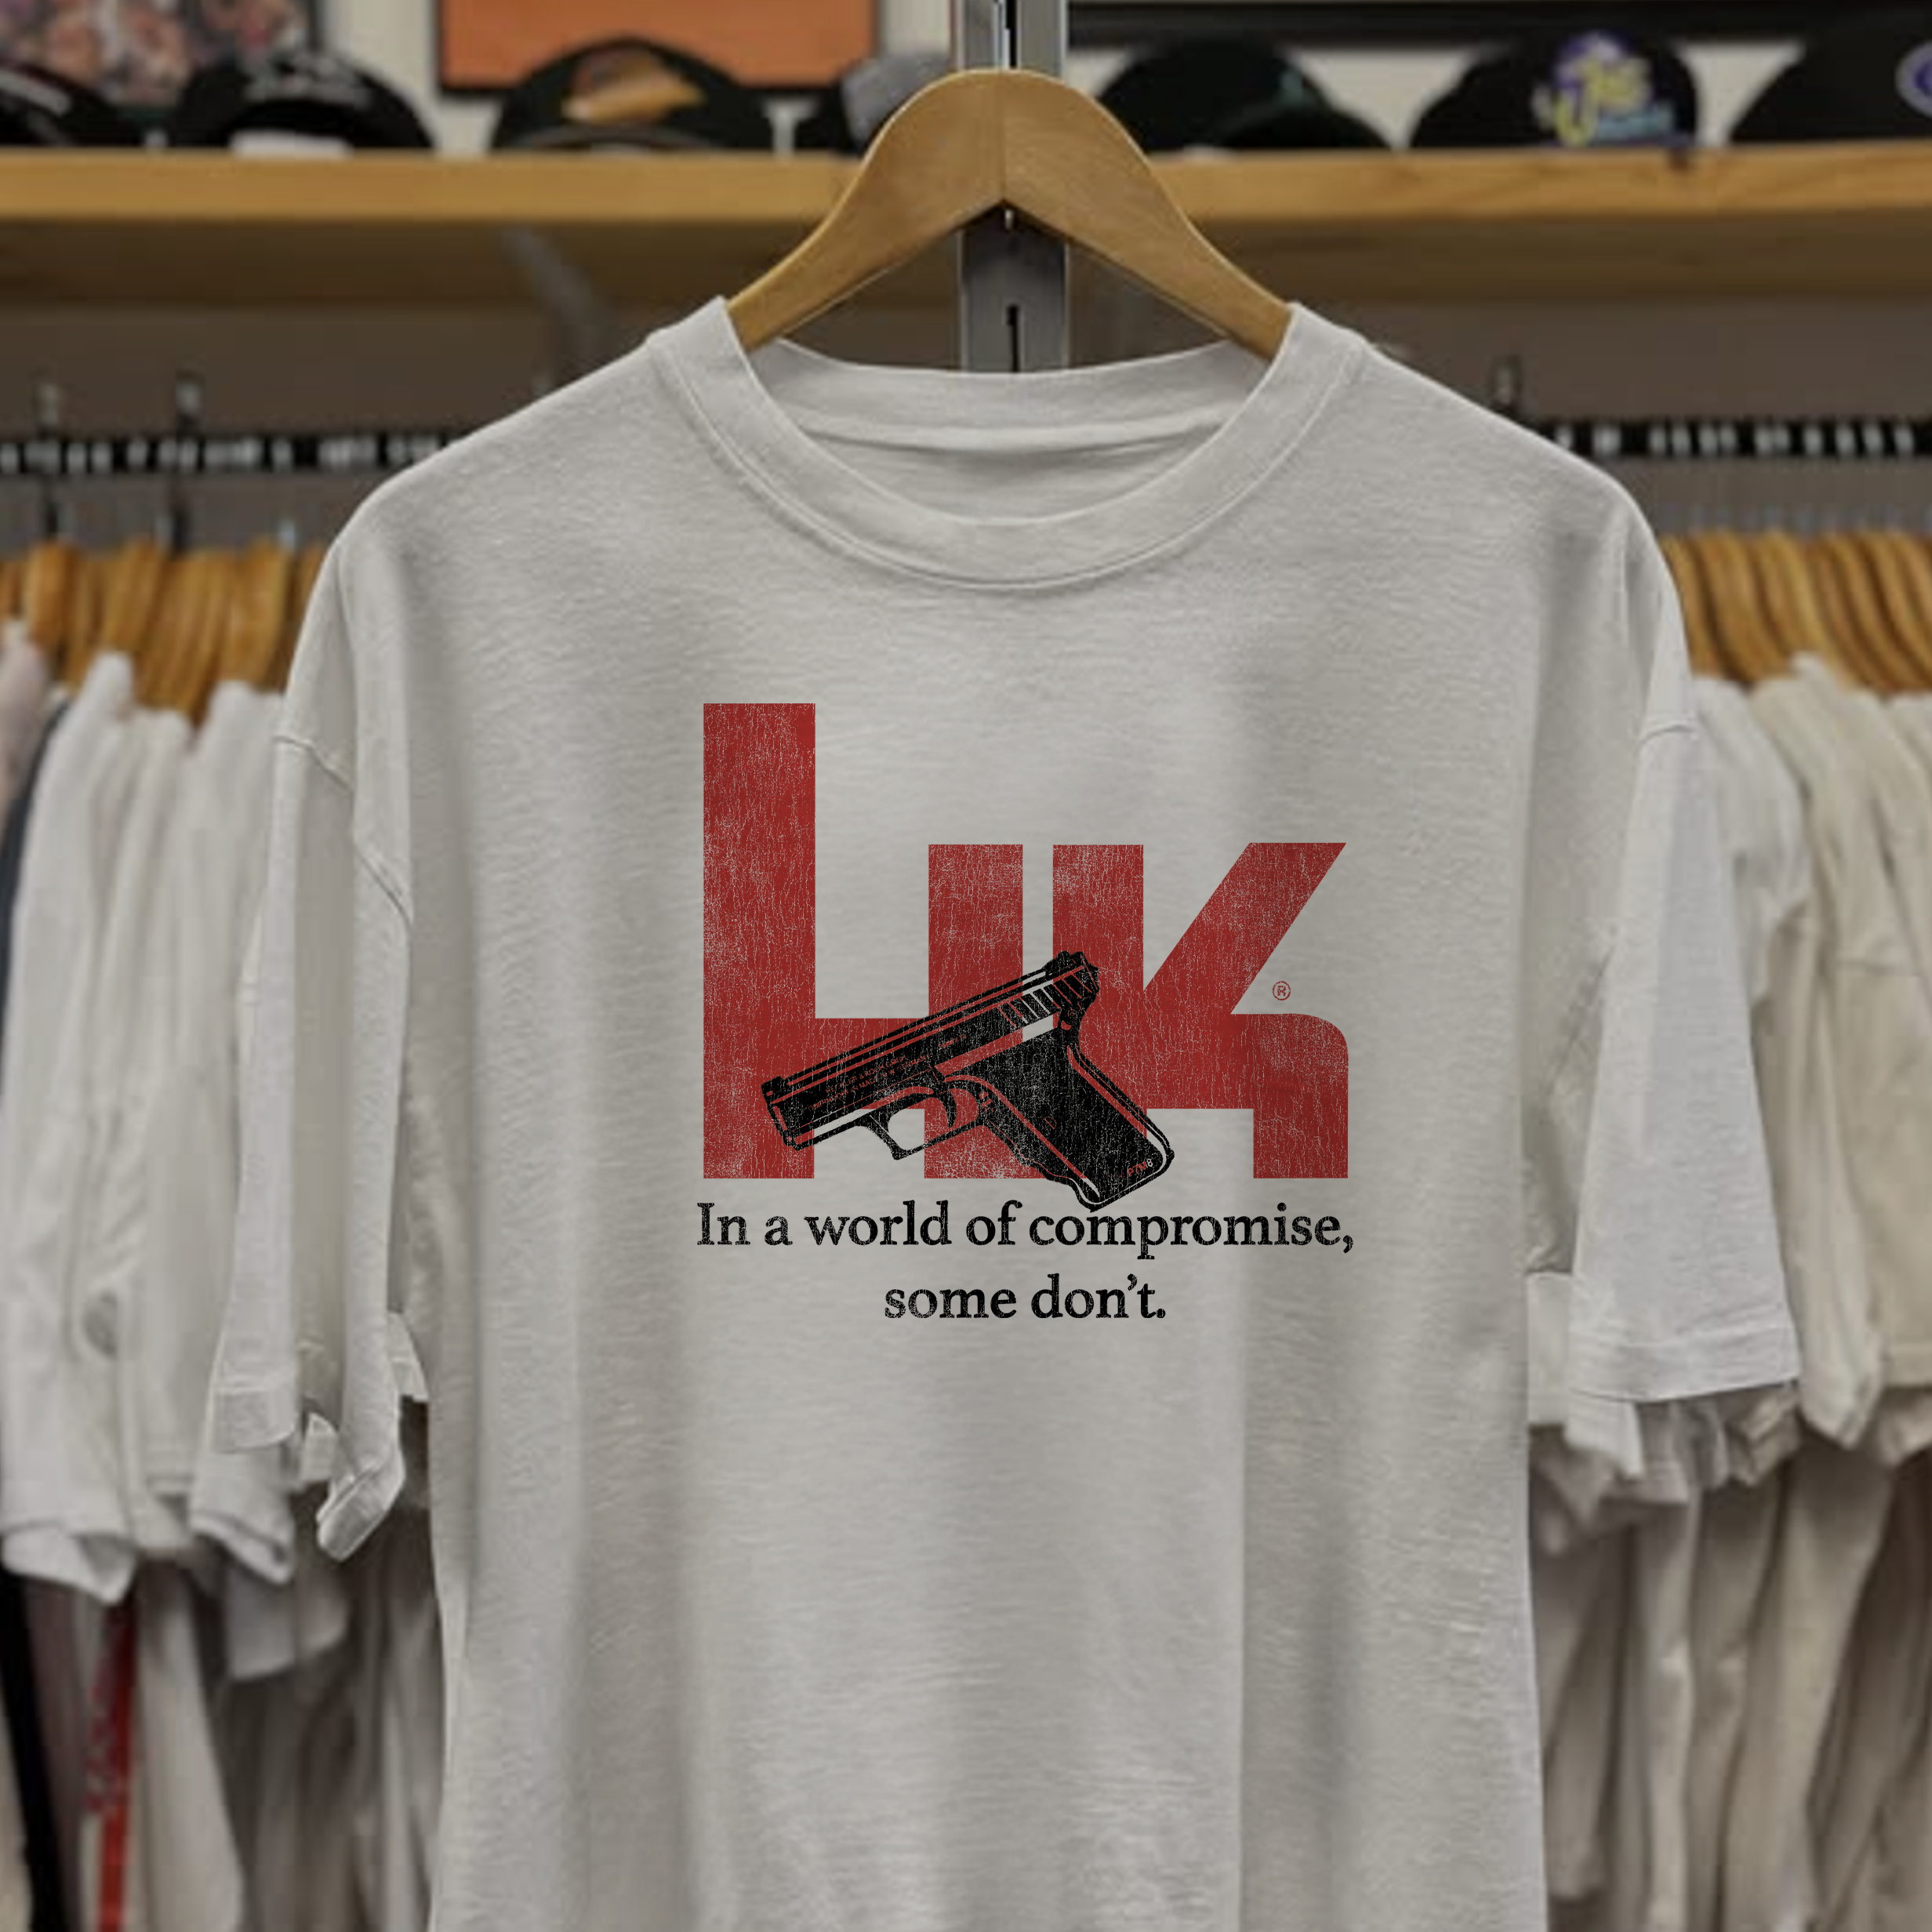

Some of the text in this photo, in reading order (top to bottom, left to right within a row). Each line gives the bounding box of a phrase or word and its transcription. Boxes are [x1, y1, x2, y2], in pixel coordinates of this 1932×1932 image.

[1127, 1158, 1153, 1177] P7M8
[697, 1200, 1354, 1260] In a world of compromise,
[884, 1273, 1166, 1319] some don’t.
